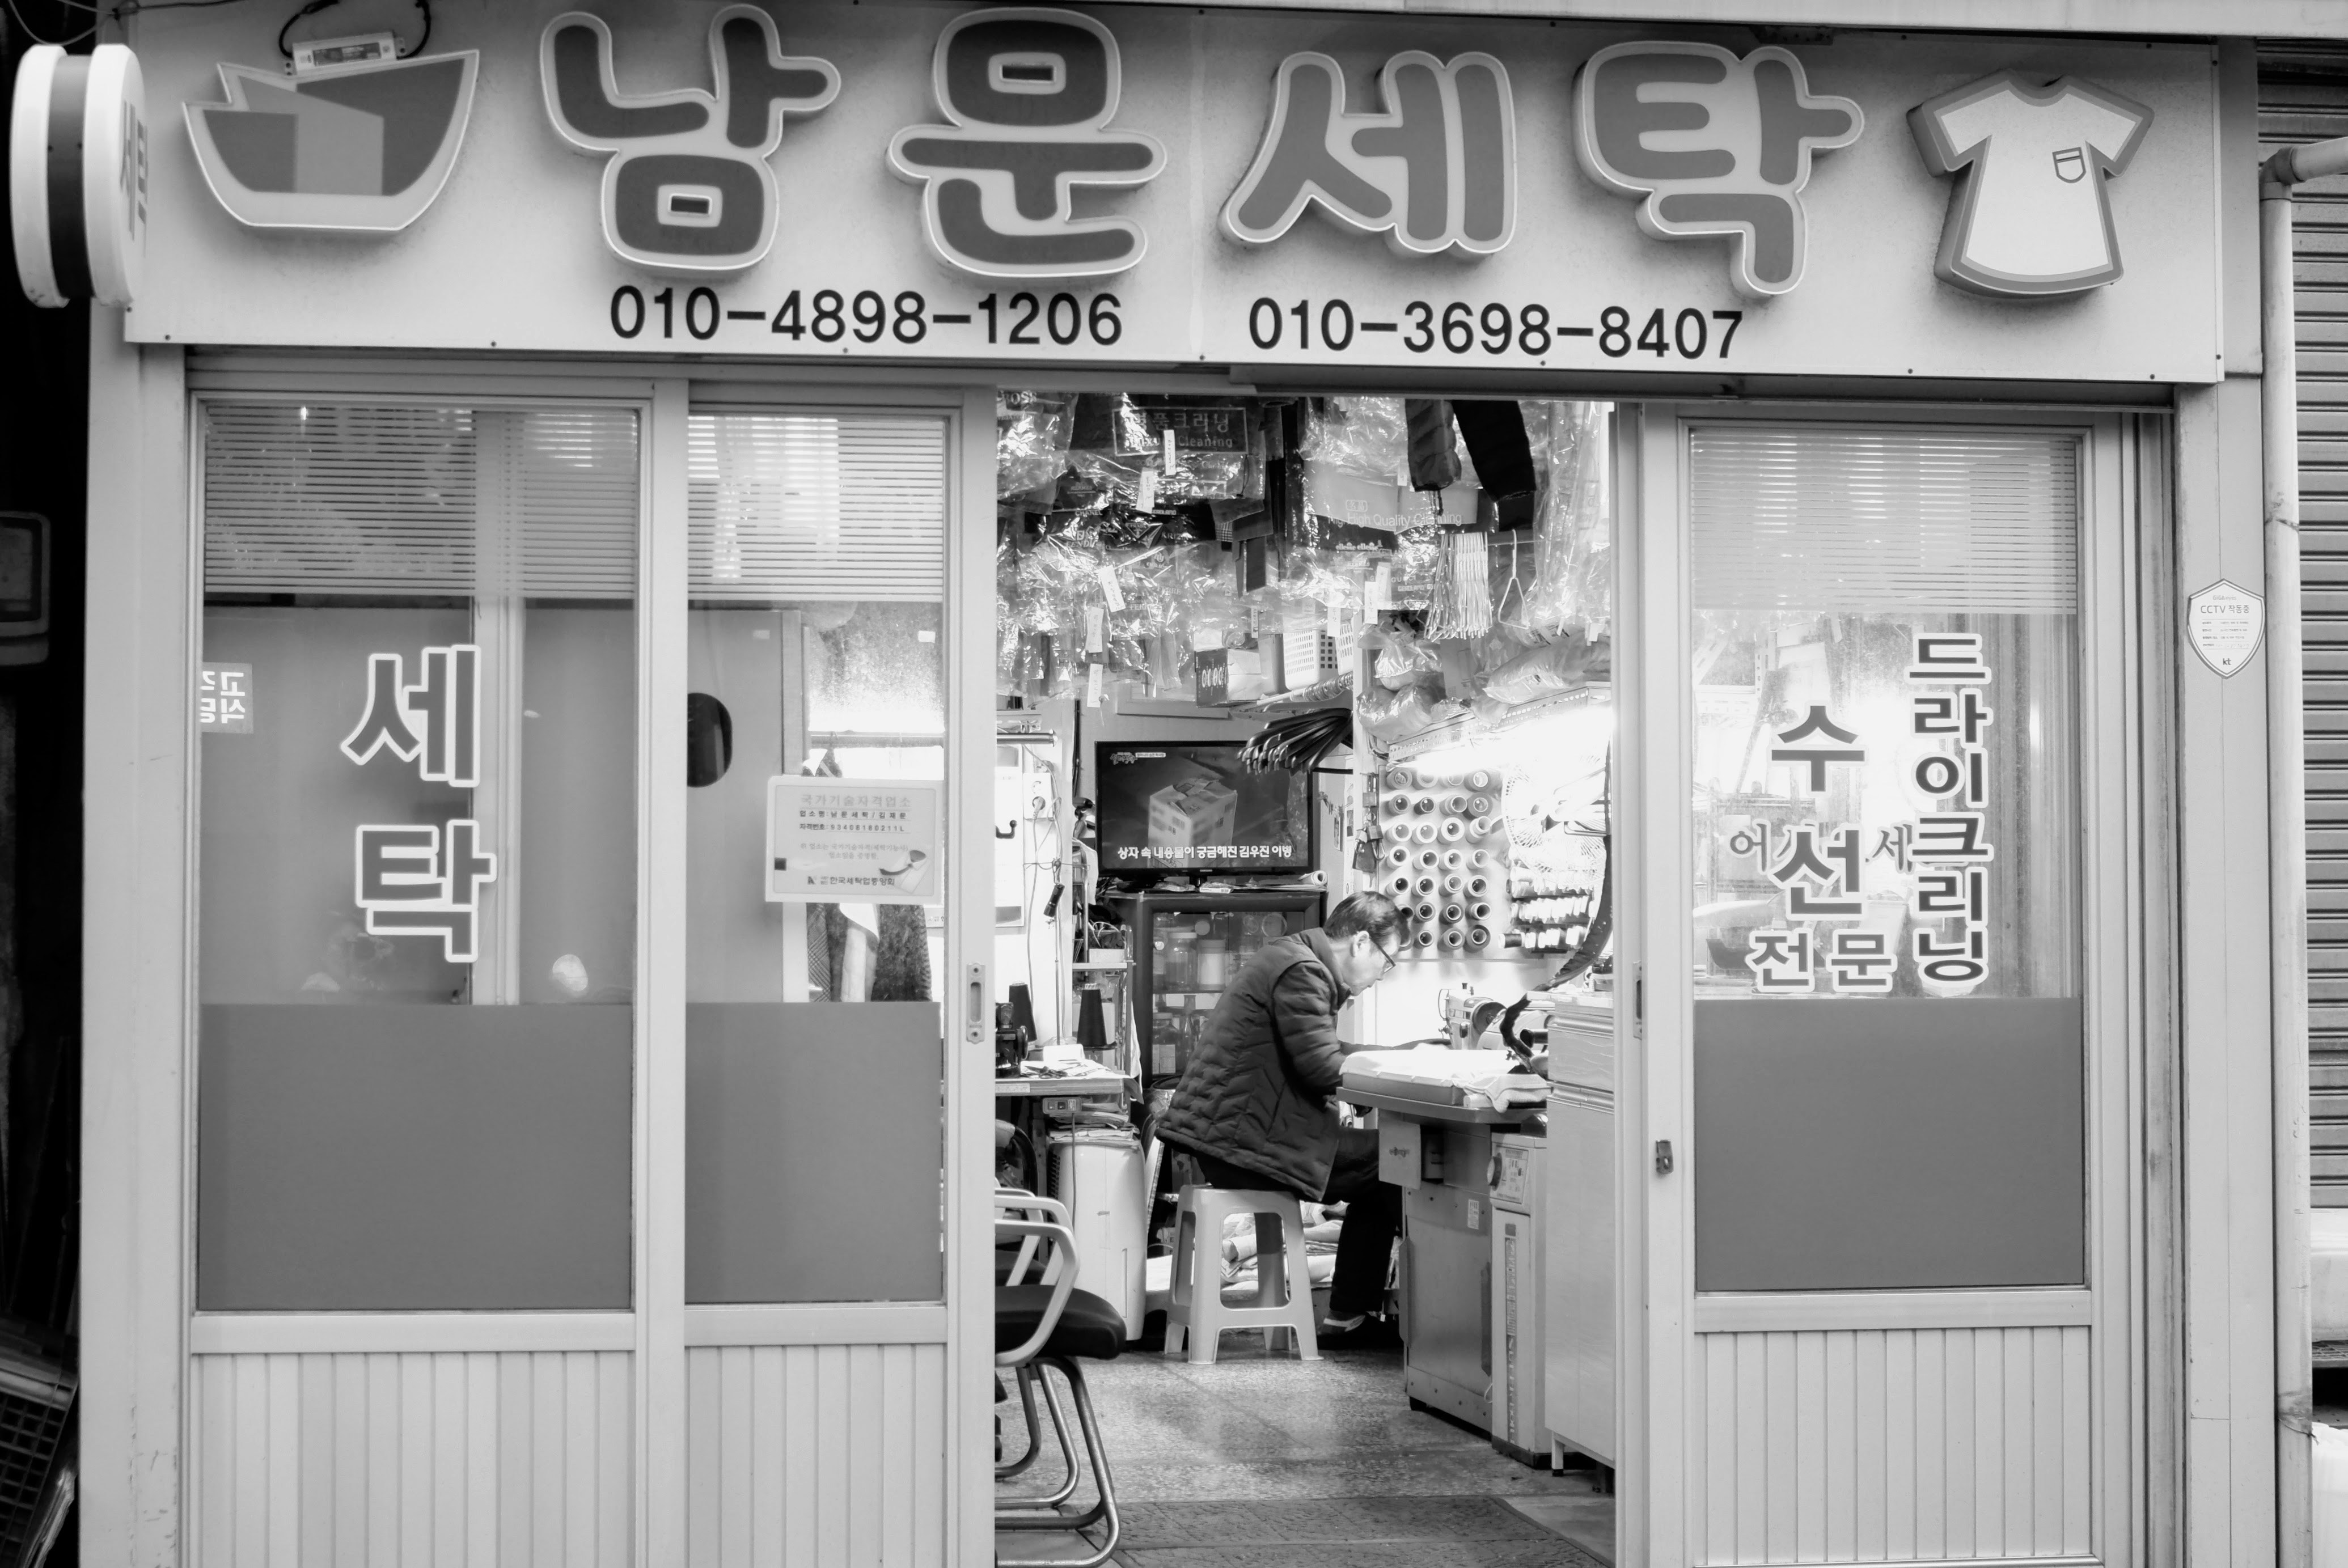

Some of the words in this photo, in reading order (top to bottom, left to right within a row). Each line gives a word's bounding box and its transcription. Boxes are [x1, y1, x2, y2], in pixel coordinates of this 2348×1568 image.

[610, 285, 1123, 346] 010-4898-1206
[1248, 298, 1744, 359] 010-3698-8407
[1178, 435, 1233, 448] Cleaning
[1347, 512, 1370, 527] High
[1373, 513, 1411, 529] Quality
[2201, 605, 2226, 613] CCTV
[2228, 604, 2250, 614] 작동중
[341, 645, 497, 962] 세탁
[1768, 702, 1867, 918] 수선
[1906, 635, 1992, 986] 드라이크리닝
[1118, 846, 1139, 860] 상자
[1141, 847, 1152, 859] 속
[1153, 846, 1195, 859] 내용물이
[1196, 845, 1238, 859] 궁금해진
[1239, 845, 1270, 859] 김우진
[1271, 845, 1293, 858] 이병
[1746, 929, 1897, 991] 전문
